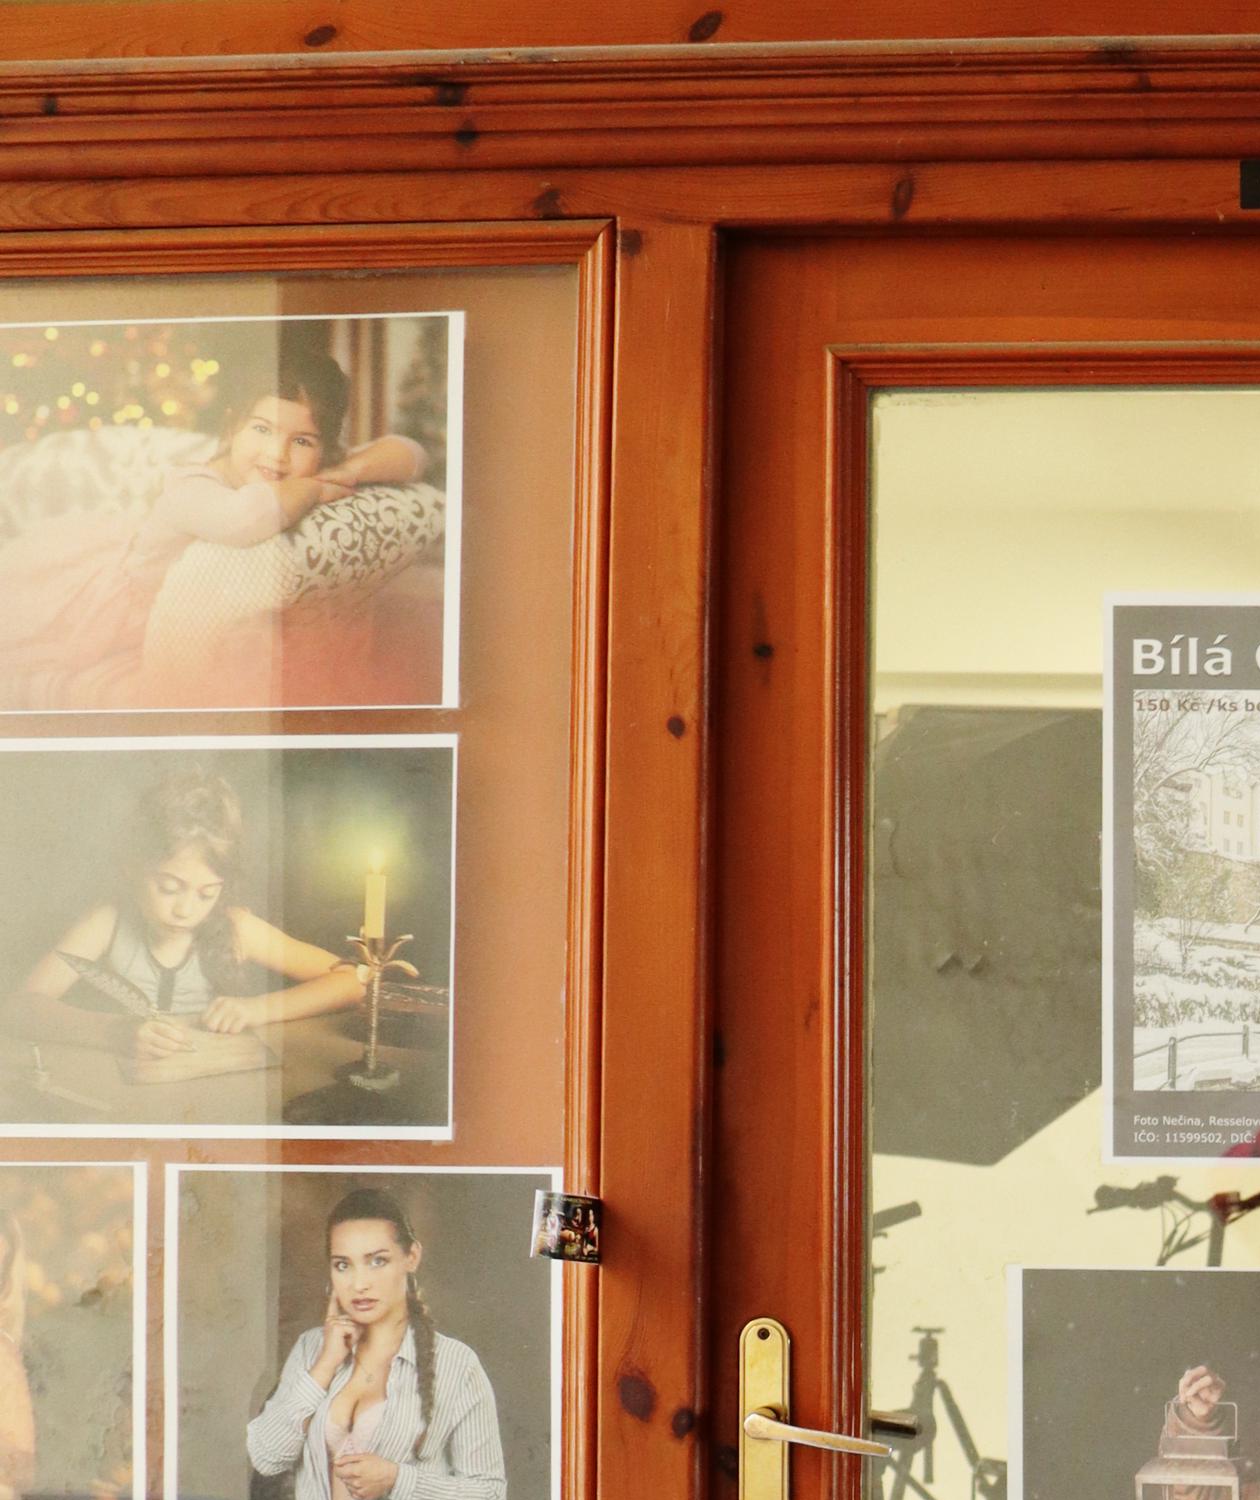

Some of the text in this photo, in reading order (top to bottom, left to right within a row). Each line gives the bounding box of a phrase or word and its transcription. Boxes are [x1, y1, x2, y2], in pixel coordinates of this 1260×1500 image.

[1133, 634, 1232, 676] Bílá
[1136, 698, 1170, 712] 150
[1133, 1115, 1159, 1126] Foto
[1162, 1115, 1205, 1128] Nečina,
[1134, 1131, 1160, 1143] IČO:
[1164, 1132, 1226, 1145] 11599502,
[1230, 1131, 1256, 1143] DIČ:
